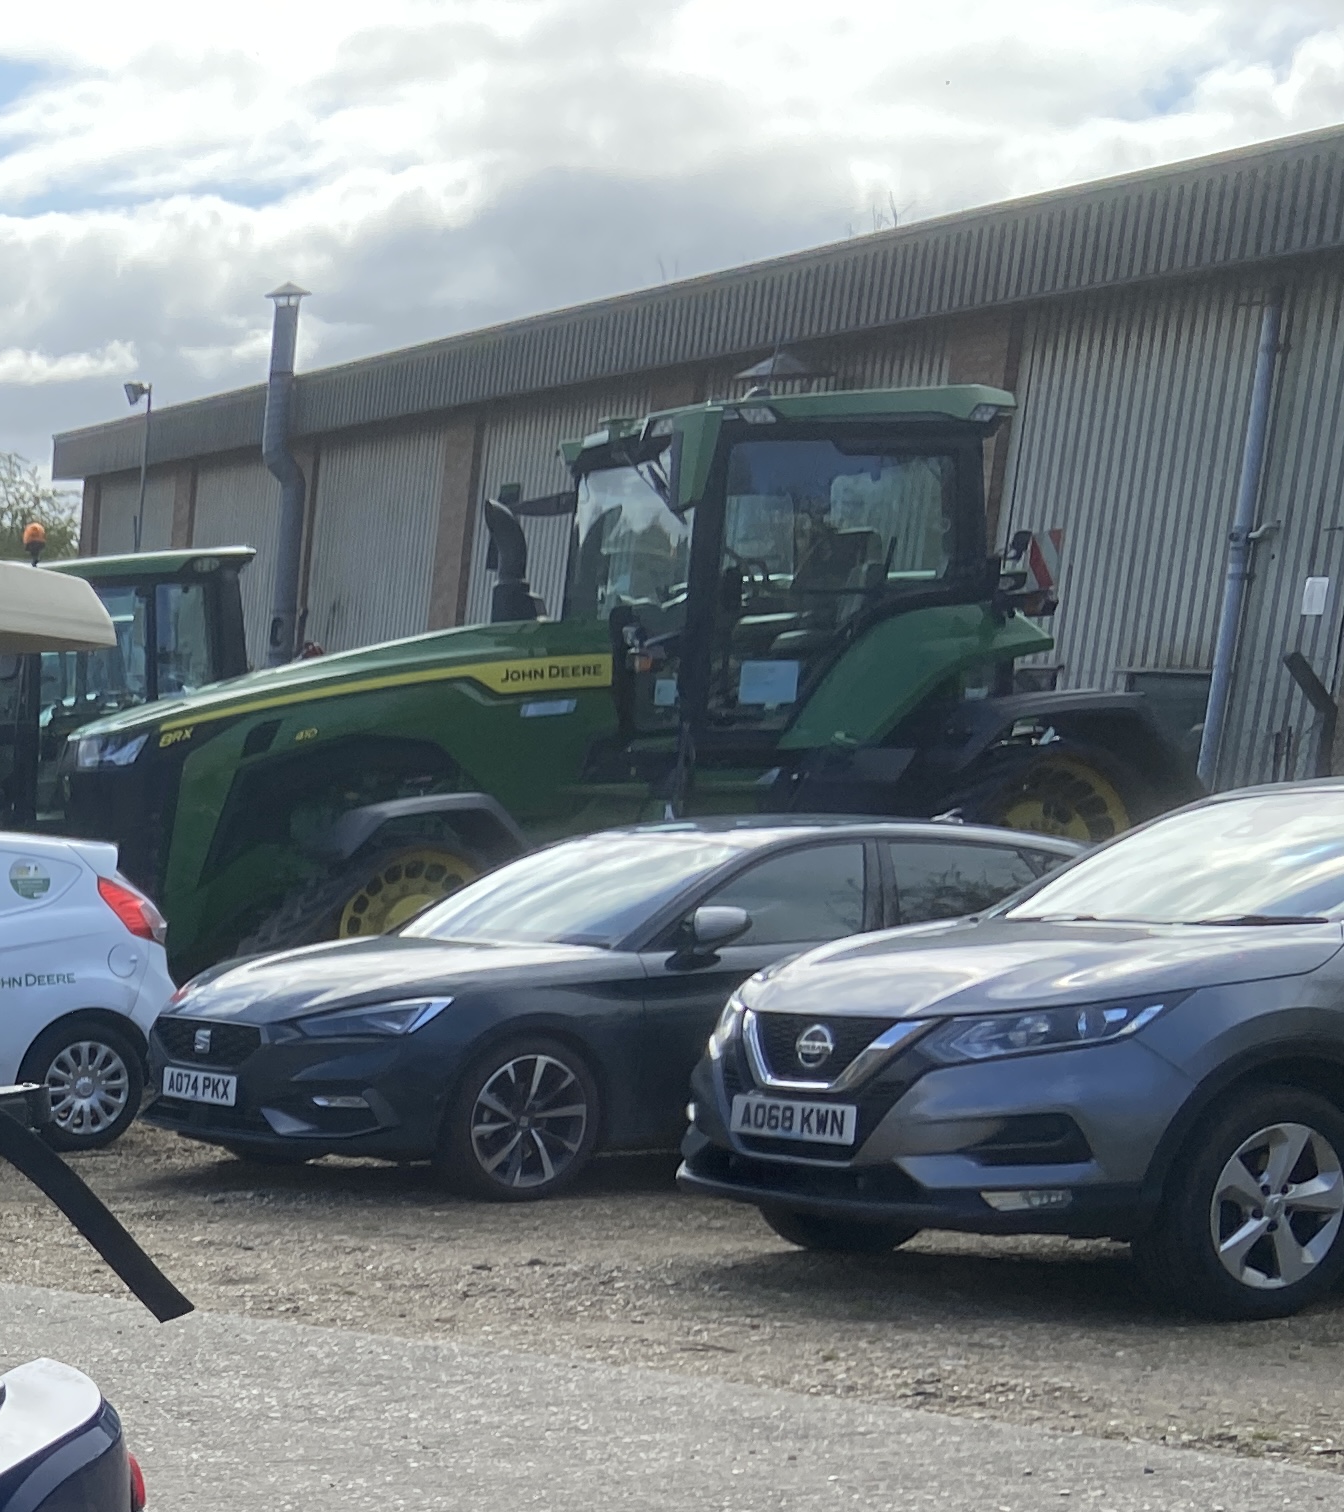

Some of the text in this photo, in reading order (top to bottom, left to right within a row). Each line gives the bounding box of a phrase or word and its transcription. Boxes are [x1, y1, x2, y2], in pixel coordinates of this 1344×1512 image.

[500, 663, 603, 684] JOHN DEERE
[25, 972, 76, 987] DEERE
[202, 1076, 231, 1101] PKX
[800, 1107, 845, 1137] KWN
